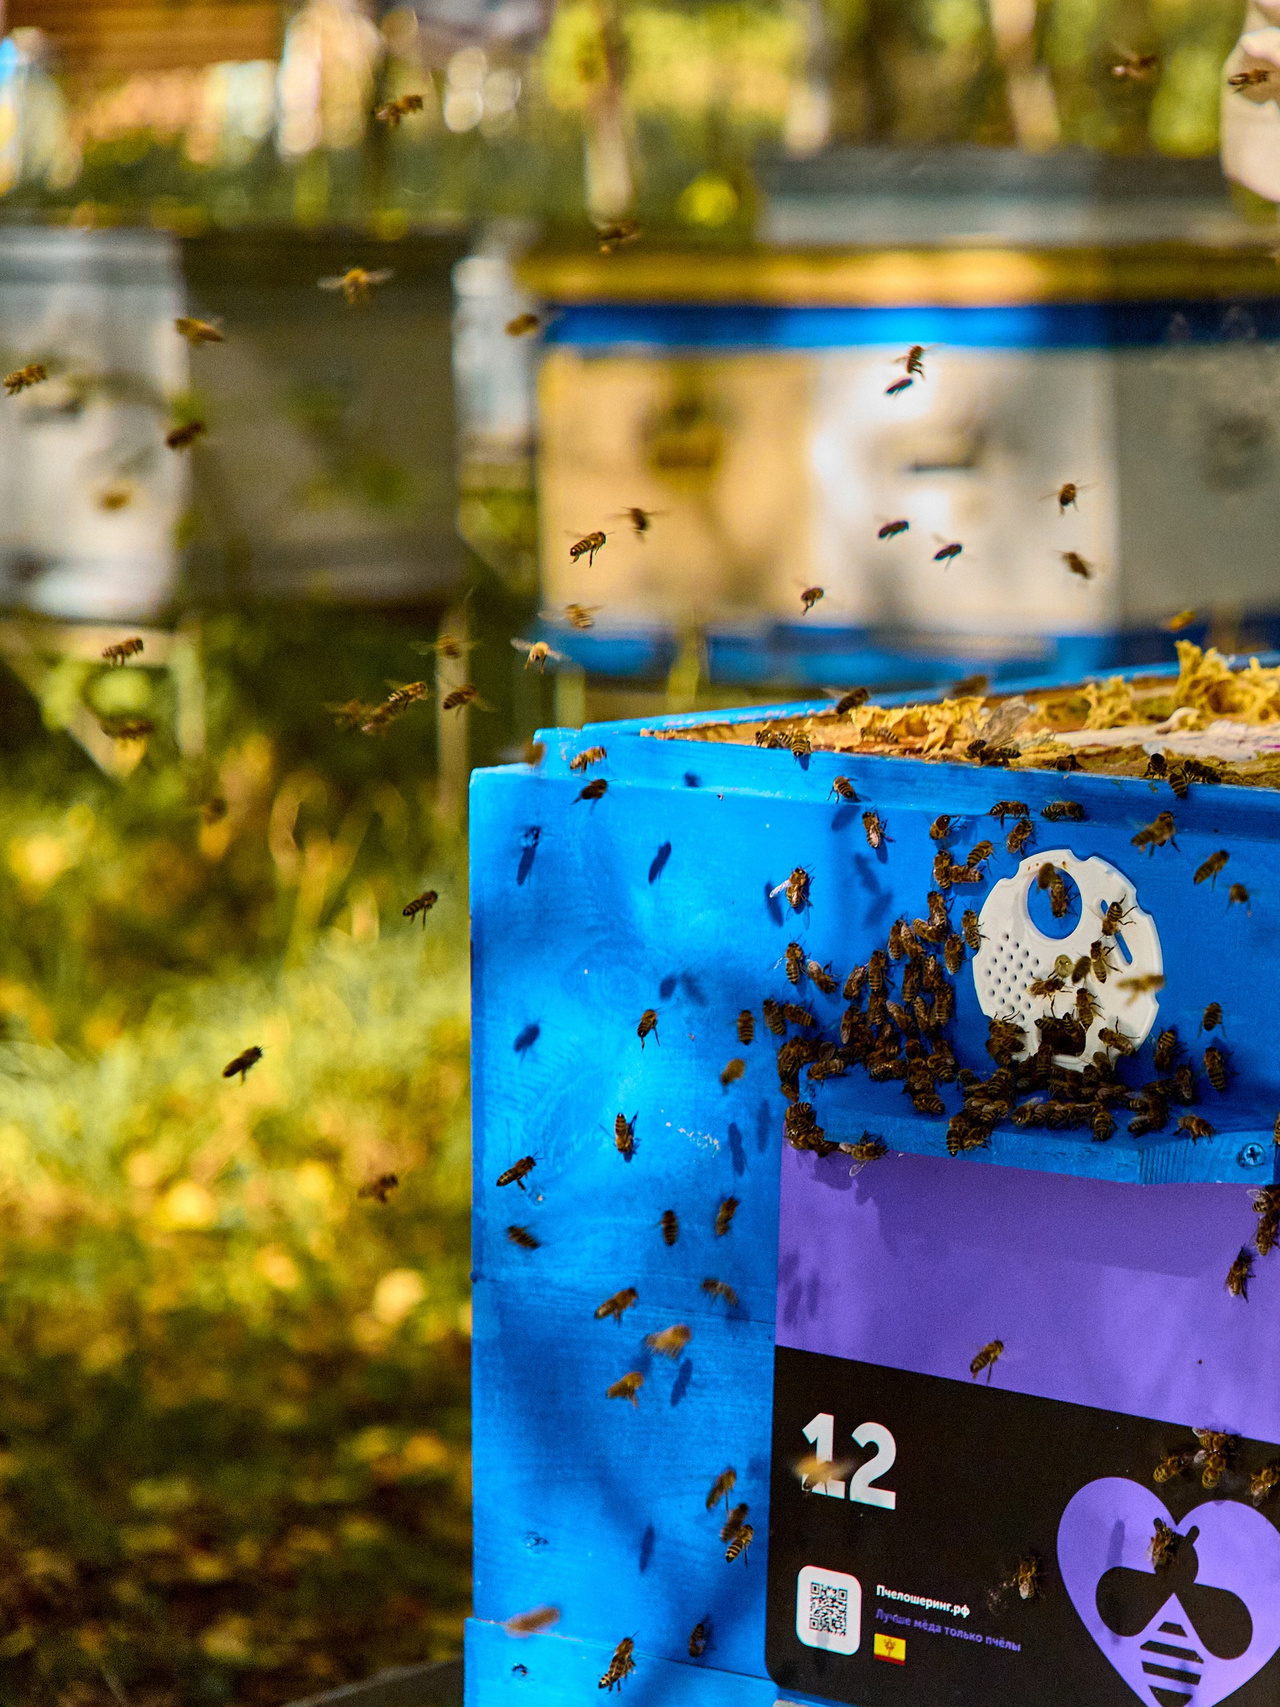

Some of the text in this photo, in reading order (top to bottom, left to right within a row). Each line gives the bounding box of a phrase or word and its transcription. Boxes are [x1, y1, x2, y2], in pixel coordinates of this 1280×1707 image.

[802, 1412, 896, 1510] 12
[876, 1584, 971, 1618] Пчелошеринг.рф
[875, 1608, 1021, 1652] Лучше мёда только пчёлы
